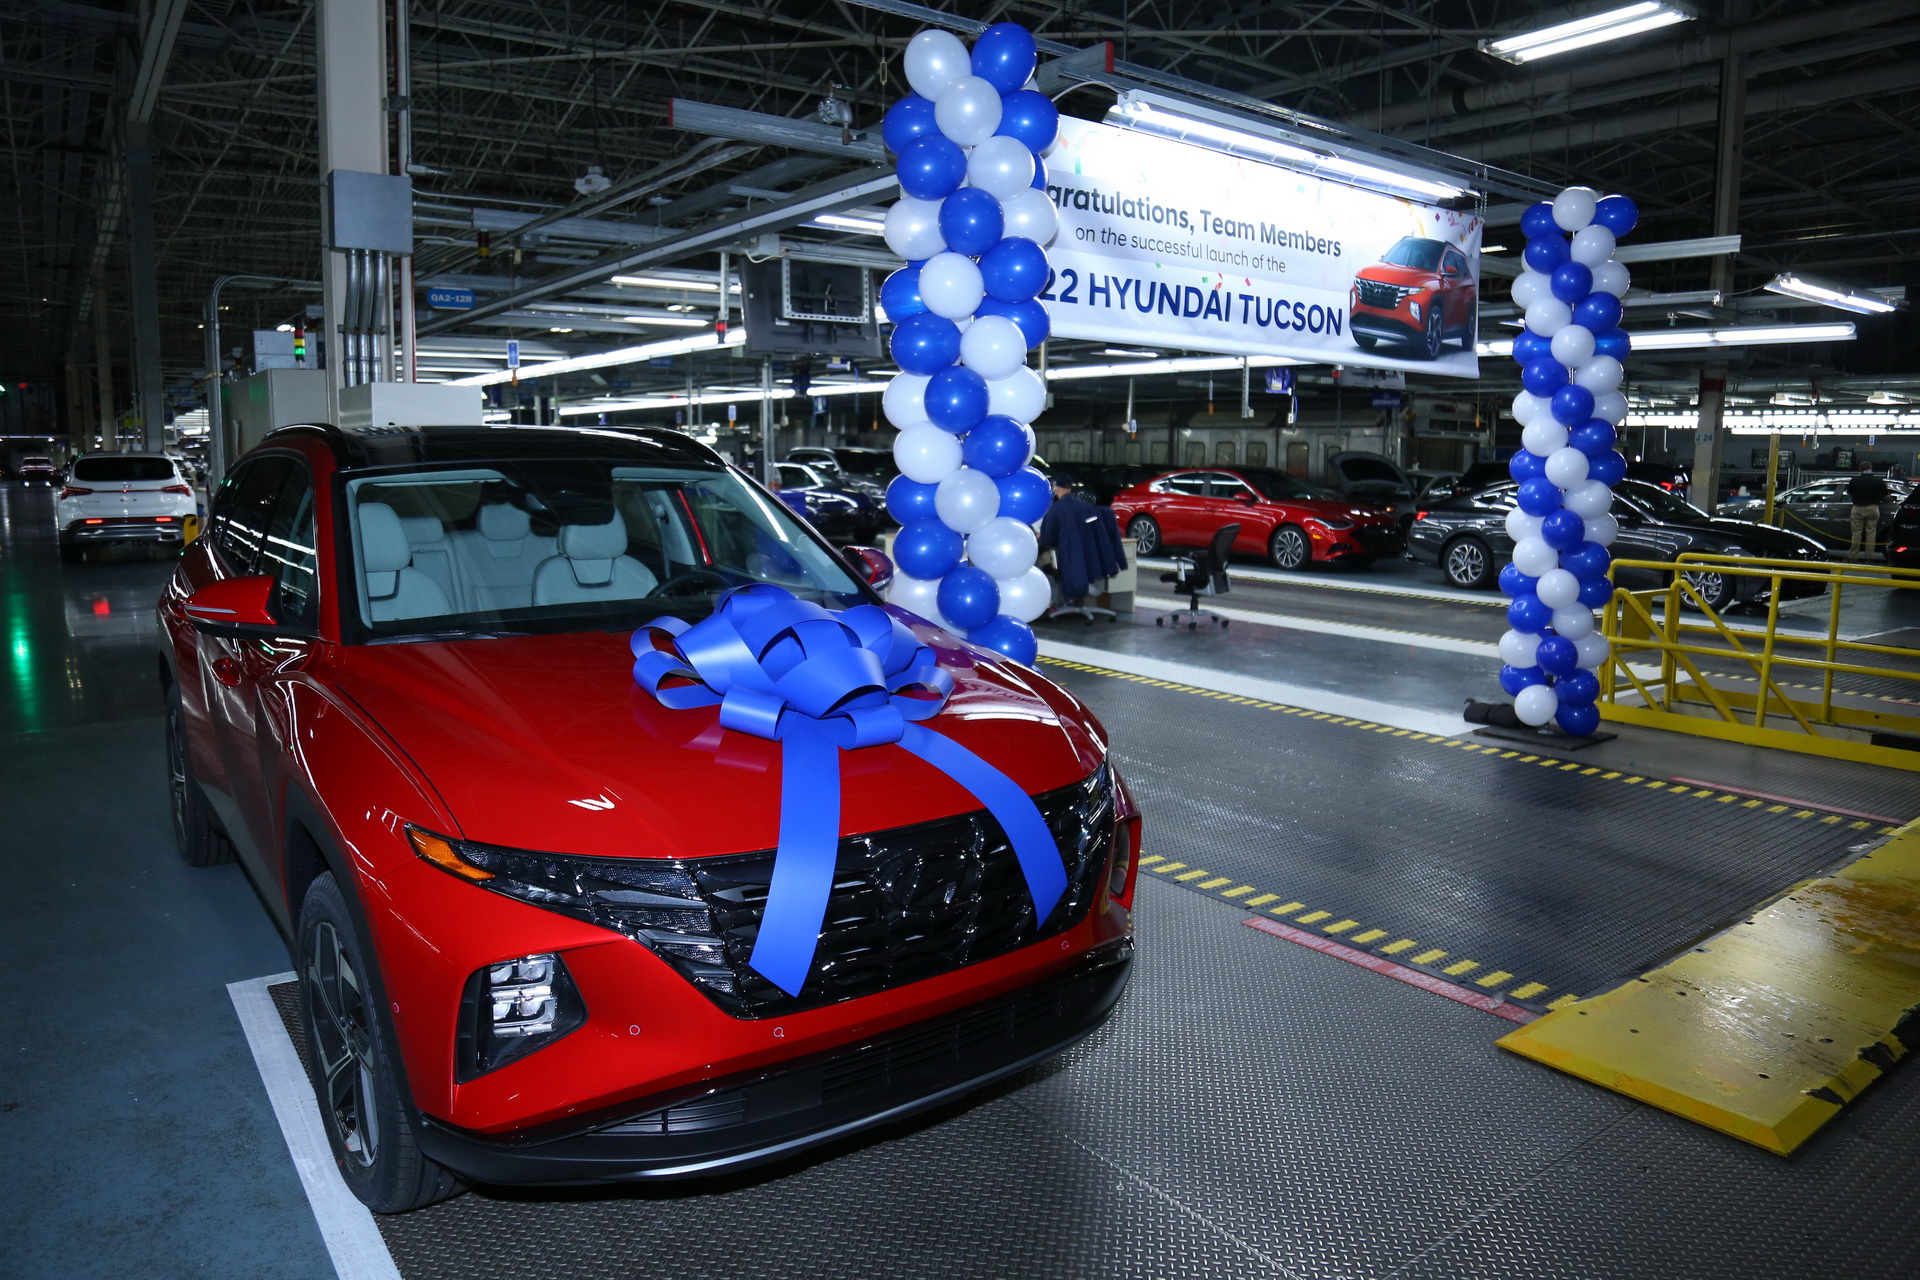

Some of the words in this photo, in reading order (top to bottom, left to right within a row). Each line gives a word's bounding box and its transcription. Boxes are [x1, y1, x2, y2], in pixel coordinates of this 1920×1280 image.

[1075, 227, 1096, 242] on
[1100, 227, 1127, 246] the
[1131, 235, 1202, 259] successful
[1206, 244, 1249, 267] launch
[1252, 254, 1264, 270] of
[1267, 256, 1286, 273] the
[1200, 208, 1255, 241] Team
[1260, 221, 1341, 257] Members
[1089, 272, 1231, 322] HYUNDAI
[1238, 293, 1343, 337] TUCSON
[1289, 932, 1334, 949] POINT
